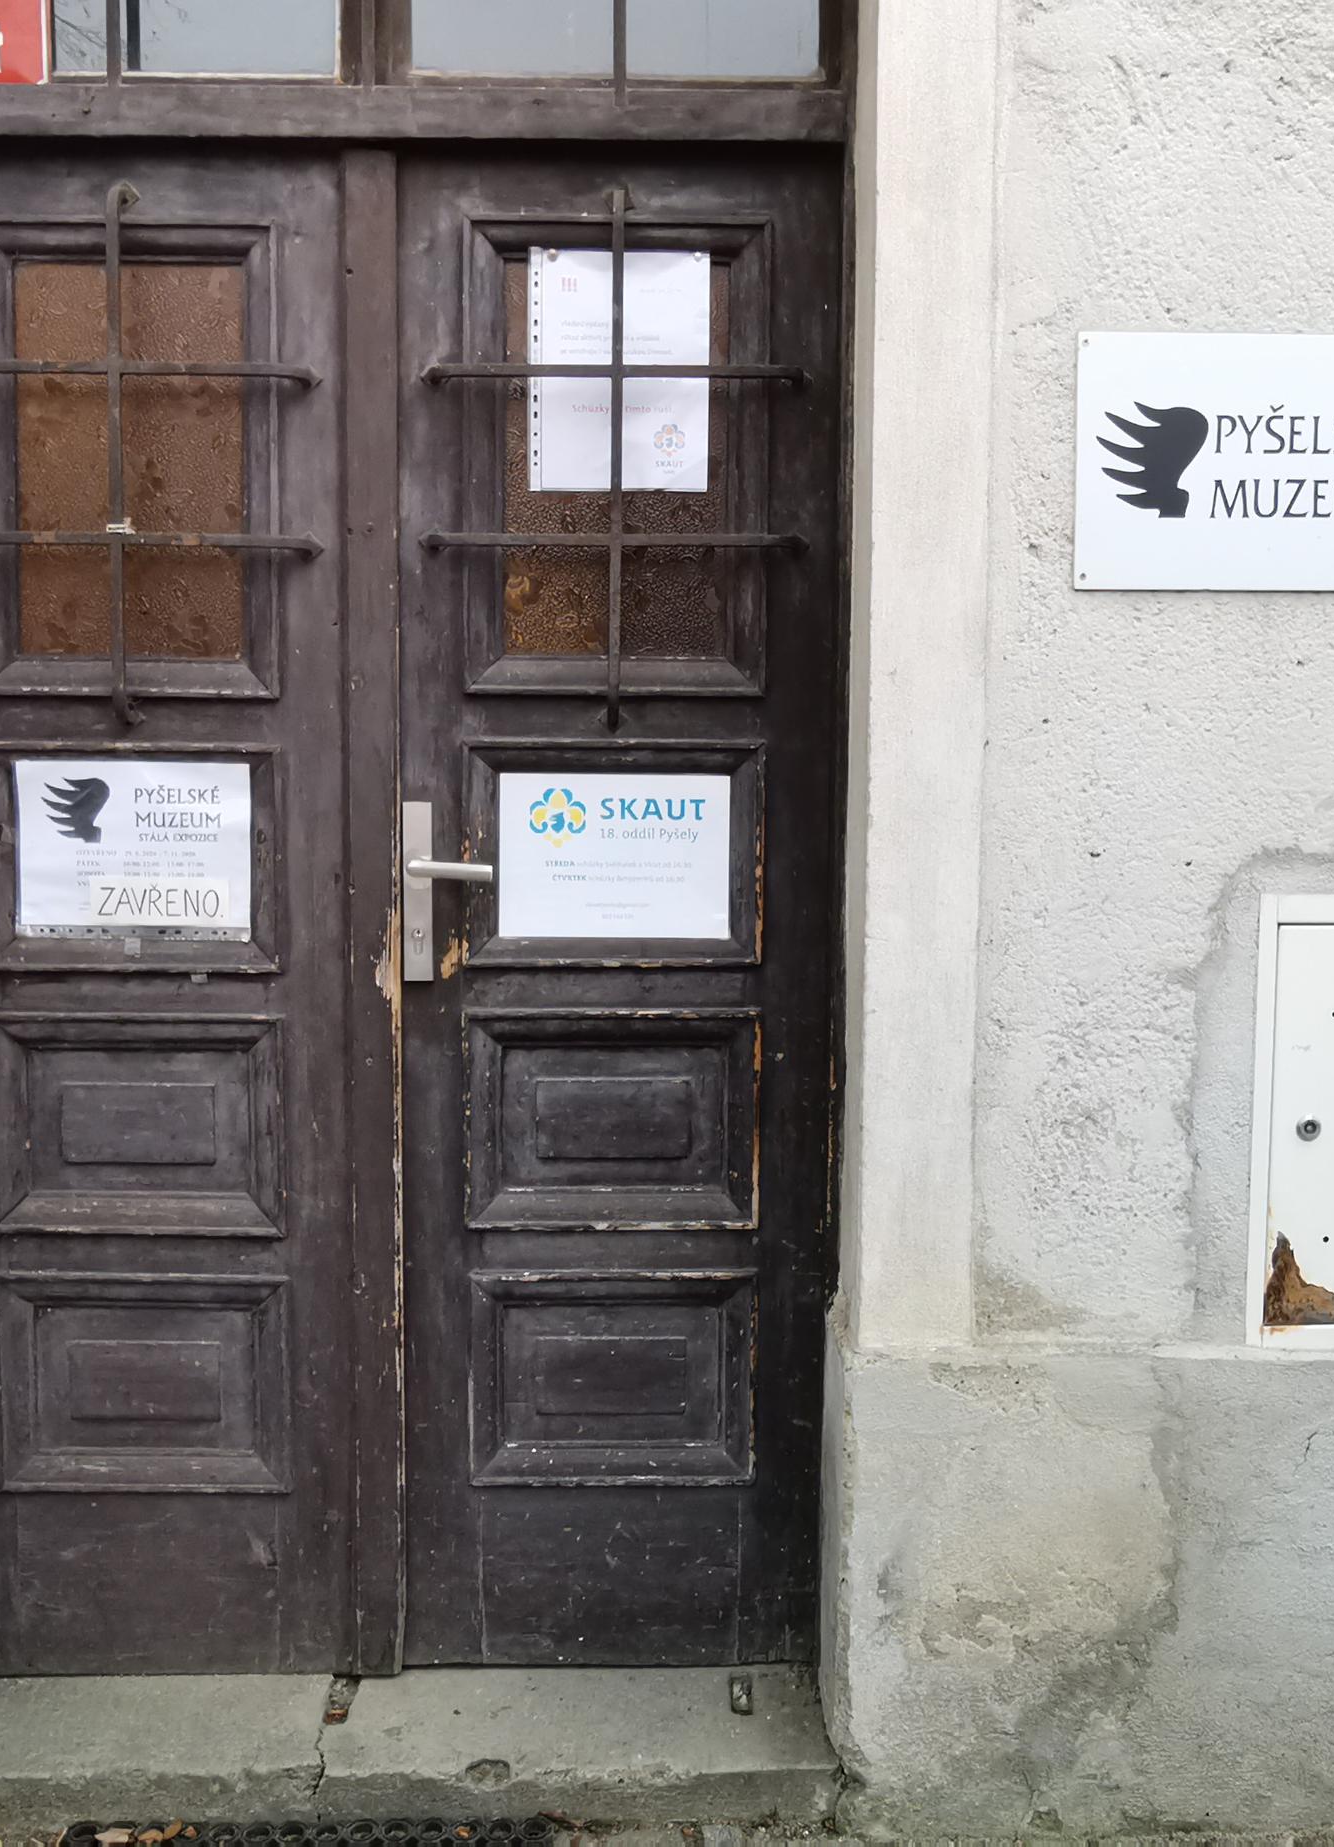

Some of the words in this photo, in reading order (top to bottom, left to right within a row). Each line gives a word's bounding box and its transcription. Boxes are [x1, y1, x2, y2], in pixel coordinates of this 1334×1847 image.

[133, 785, 221, 805] PYŠELSKÉ
[599, 798, 706, 821] SKAUT
[134, 811, 222, 829] MUZEUM
[138, 831, 170, 843] STÁLÁ
[172, 832, 218, 843] EXPOZICE
[600, 828, 618, 840] 18.
[622, 828, 655, 840] oddíl
[659, 828, 699, 844] Pyšely
